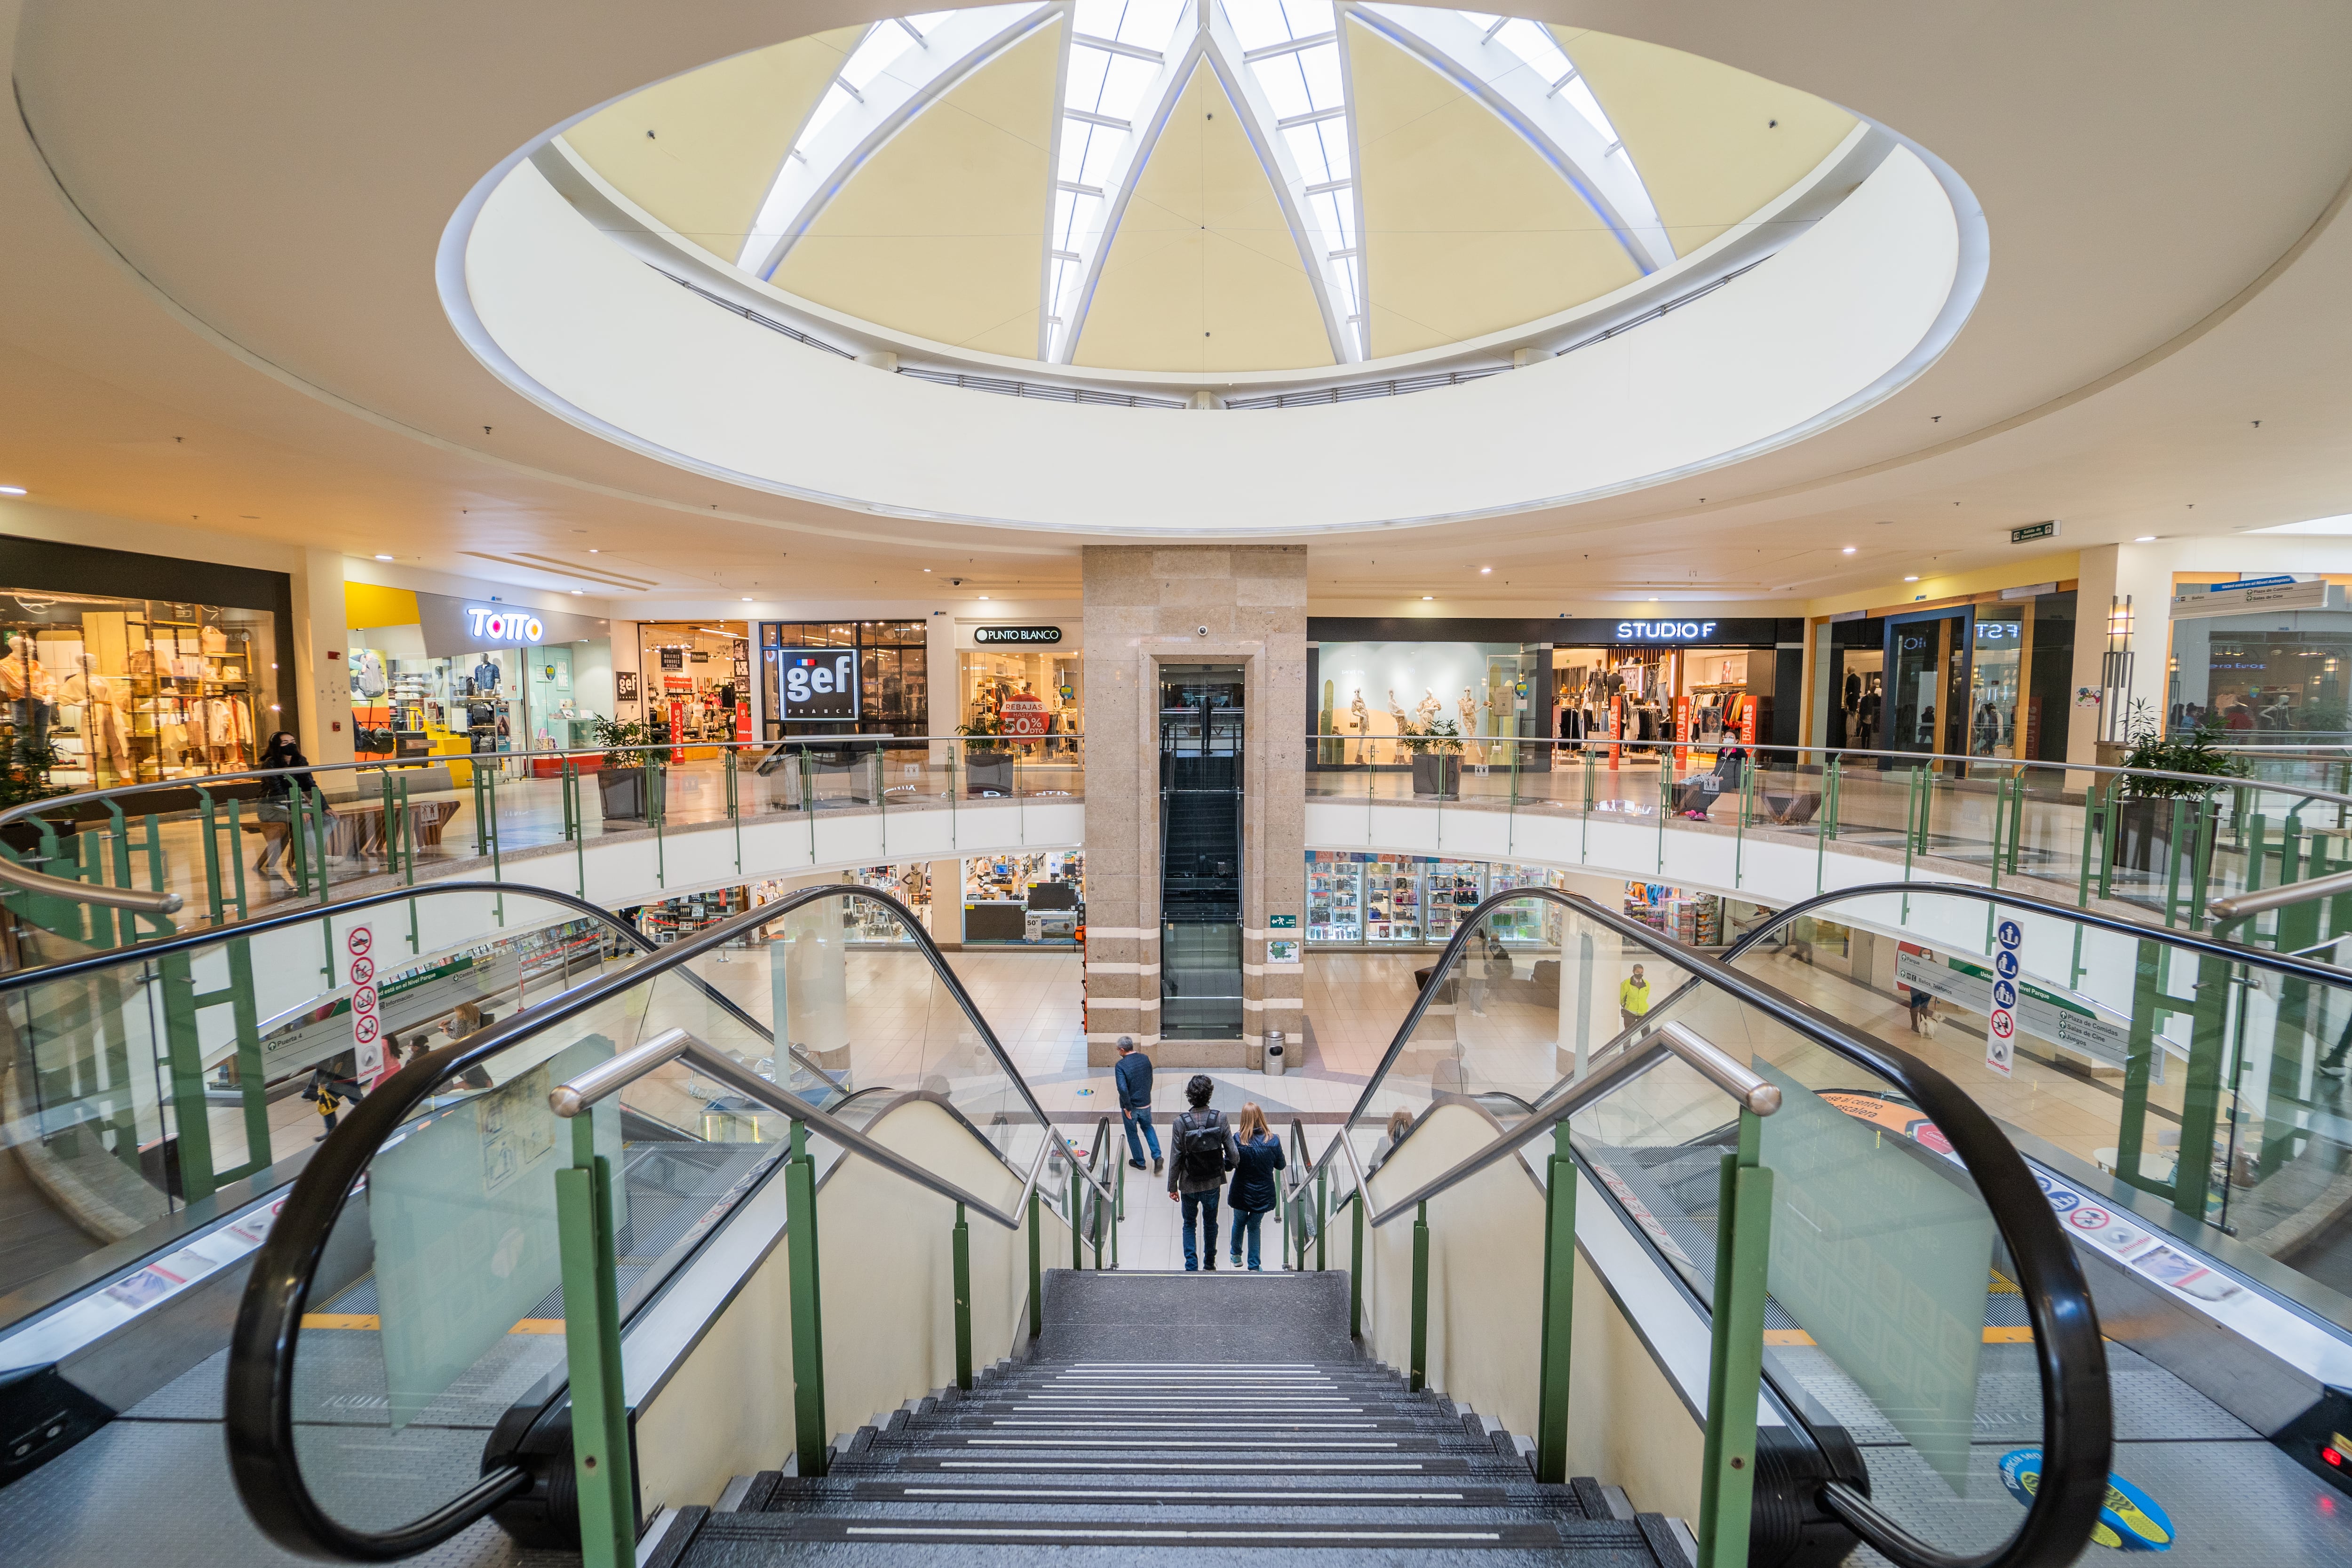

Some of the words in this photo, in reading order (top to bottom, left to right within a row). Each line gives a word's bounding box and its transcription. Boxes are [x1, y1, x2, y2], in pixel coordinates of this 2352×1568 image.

[467, 608, 543, 642] TOTTO
[1618, 622, 1698, 638] STUDIO
[1702, 622, 1716, 637] F
[988, 630, 1019, 640] PUNTO
[1021, 630, 1059, 640] BLANCO
[619, 674, 636, 694] gef
[787, 655, 850, 702] gef
[1610, 705, 1618, 755] REBAJAS
[1907, 956, 1920, 965] Parque
[459, 970, 473, 979] Centro
[473, 961, 497, 975] Empresarial
[408, 977, 420, 987] Nivel
[420, 972, 436, 983] Parque
[1933, 983, 1952, 995] Teléfonos
[2031, 988, 2050, 1000] Parque
[385, 993, 414, 1007] Información
[2068, 1014, 2082, 1024] Plaza
[2092, 1023, 2118, 1036] Comidas
[2066, 1035, 2086, 1046] Juegos
[2067, 1024, 2082, 1034] Salas
[2092, 1033, 2105, 1042] Cine
[277, 1036, 297, 1047] Puerta
[358, 1064, 382, 1078] Schindler
[1987, 1058, 2010, 1072] Schindler
[1851, 1098, 1883, 1109] centro
[1836, 1105, 1878, 1118] escalera
[230, 1226, 261, 1242] Schindler
[2118, 1236, 2151, 1254] Schindler
[2002, 1456, 2023, 1490] Distancia
